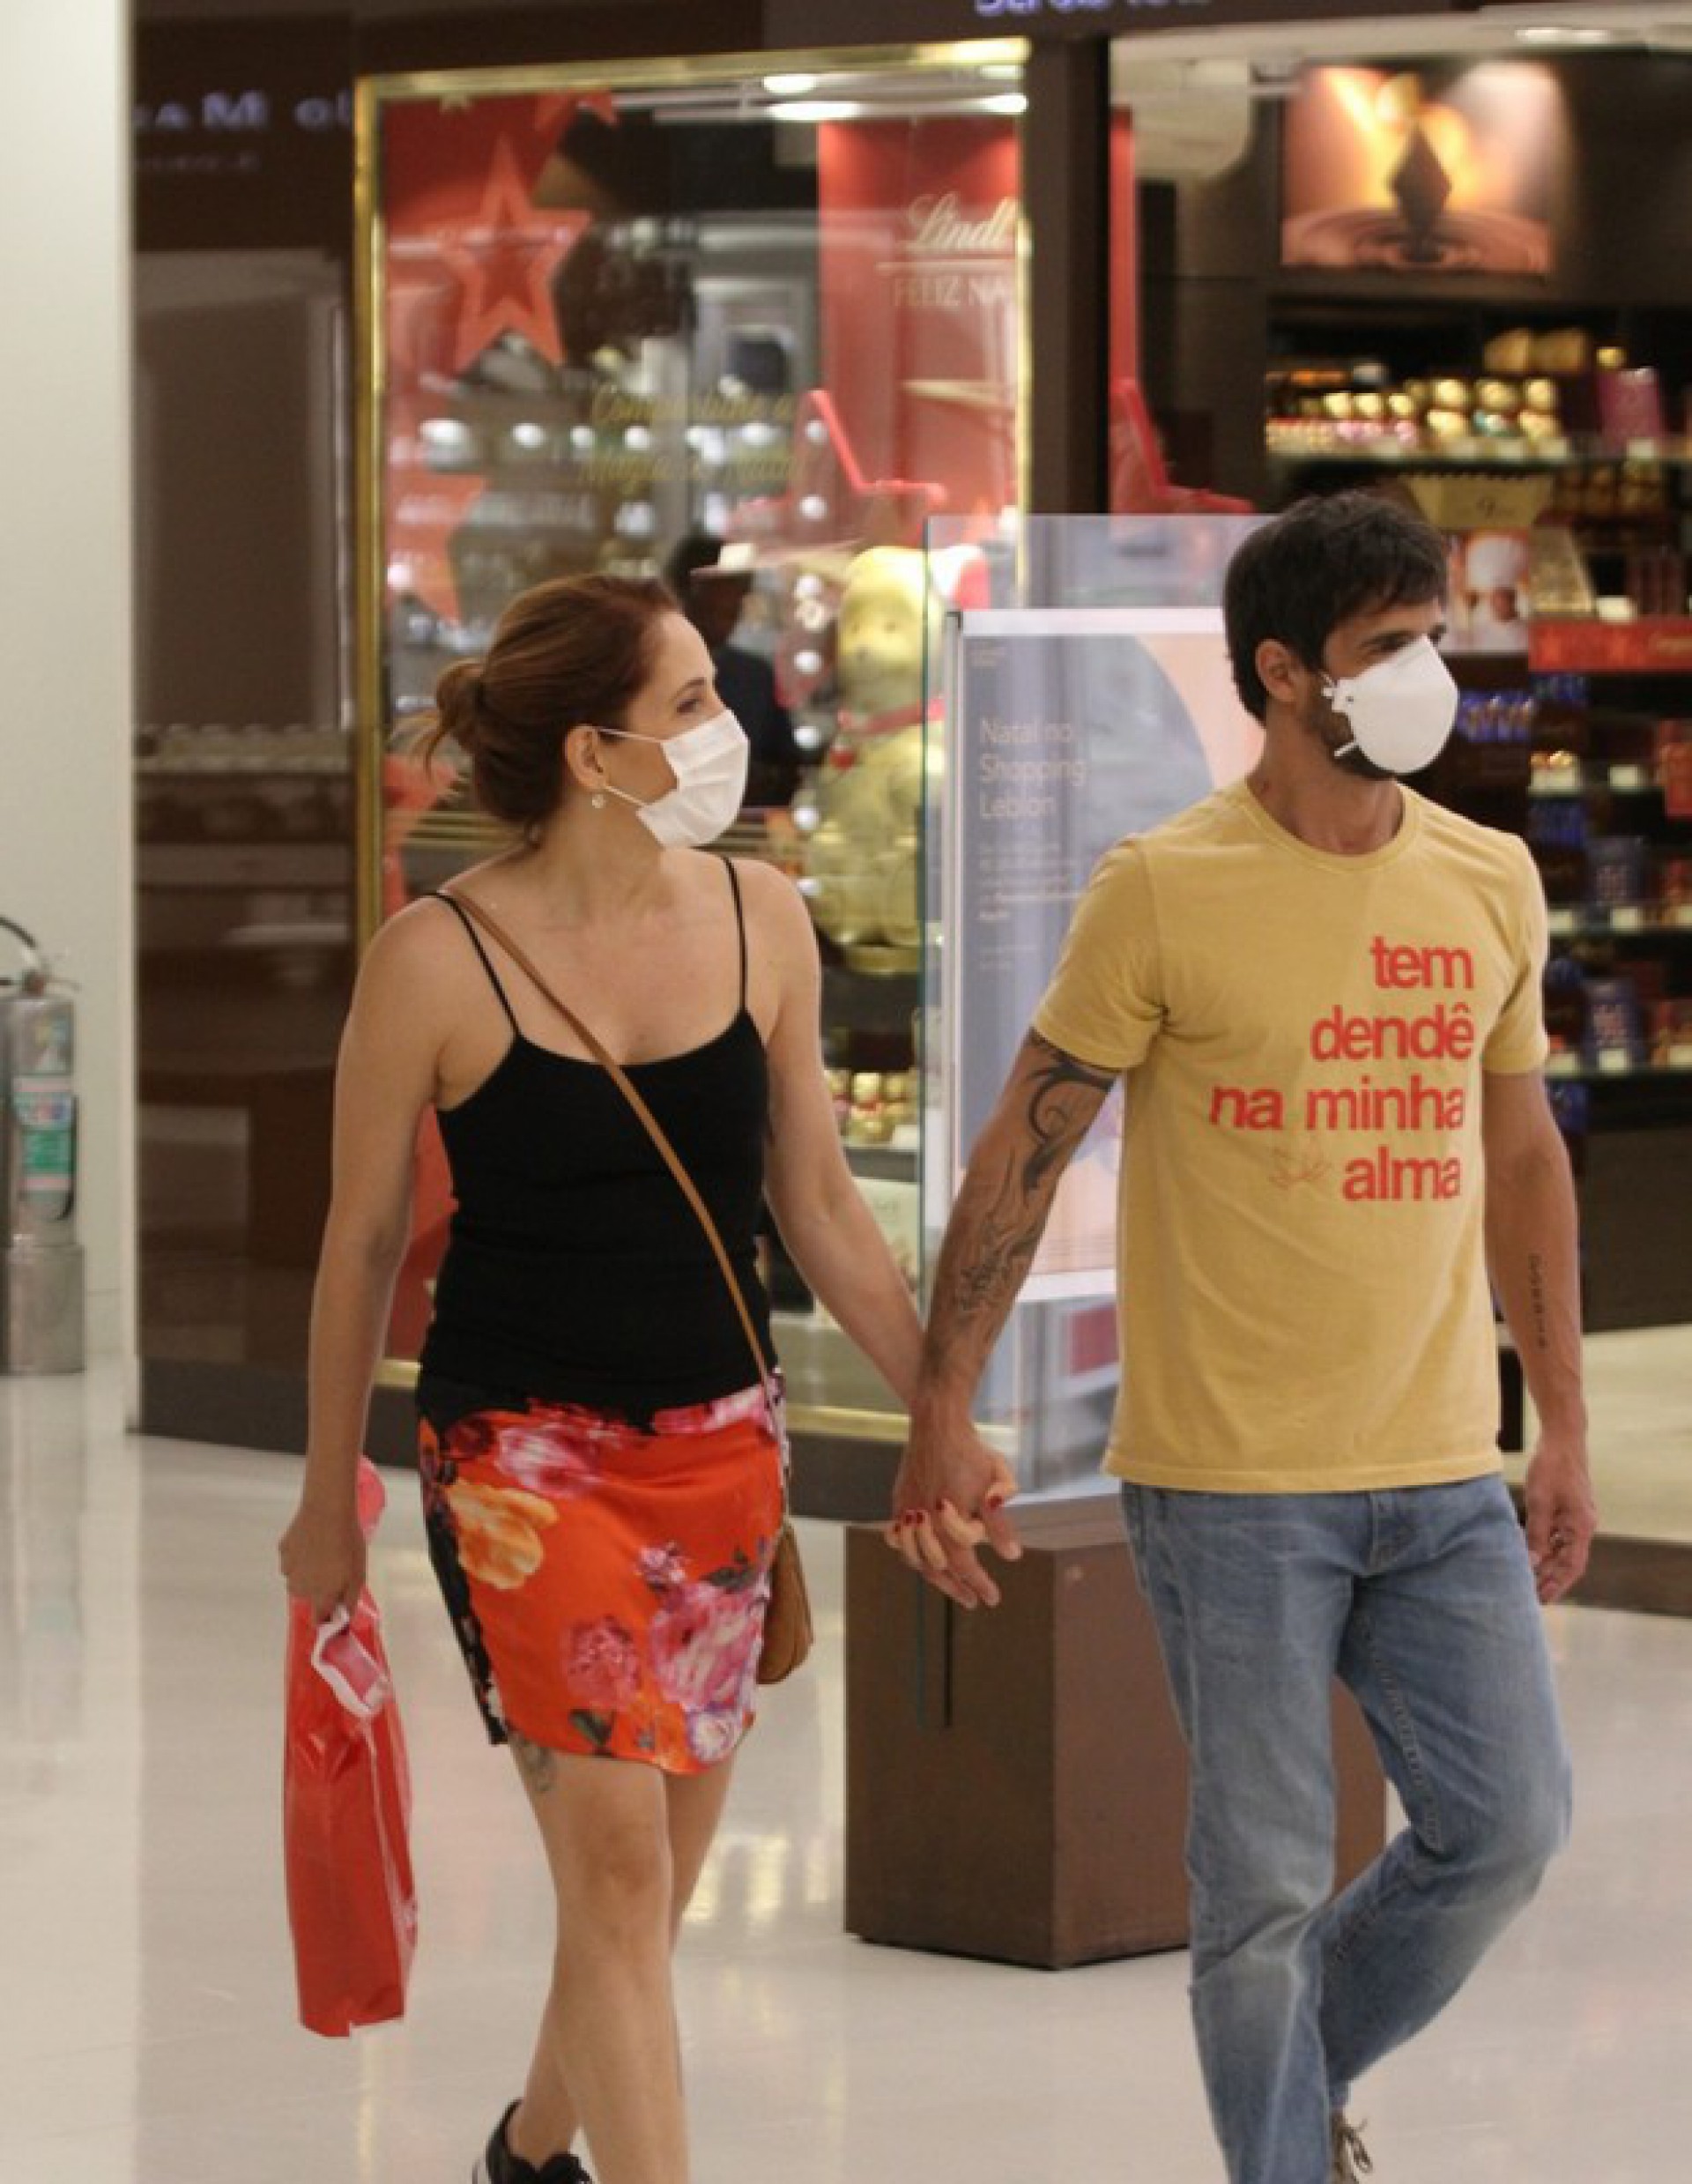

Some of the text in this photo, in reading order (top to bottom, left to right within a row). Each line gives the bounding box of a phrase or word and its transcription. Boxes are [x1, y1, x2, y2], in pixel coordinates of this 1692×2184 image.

[979, 719, 1073, 744] Natal no
[979, 753, 1087, 787] Shopping
[979, 791, 1056, 819] Leblon
[1369, 935, 1474, 989] tem
[1310, 1002, 1474, 1061] dendê
[1208, 1073, 1466, 1132] na minha
[1341, 1144, 1462, 1201] alma
